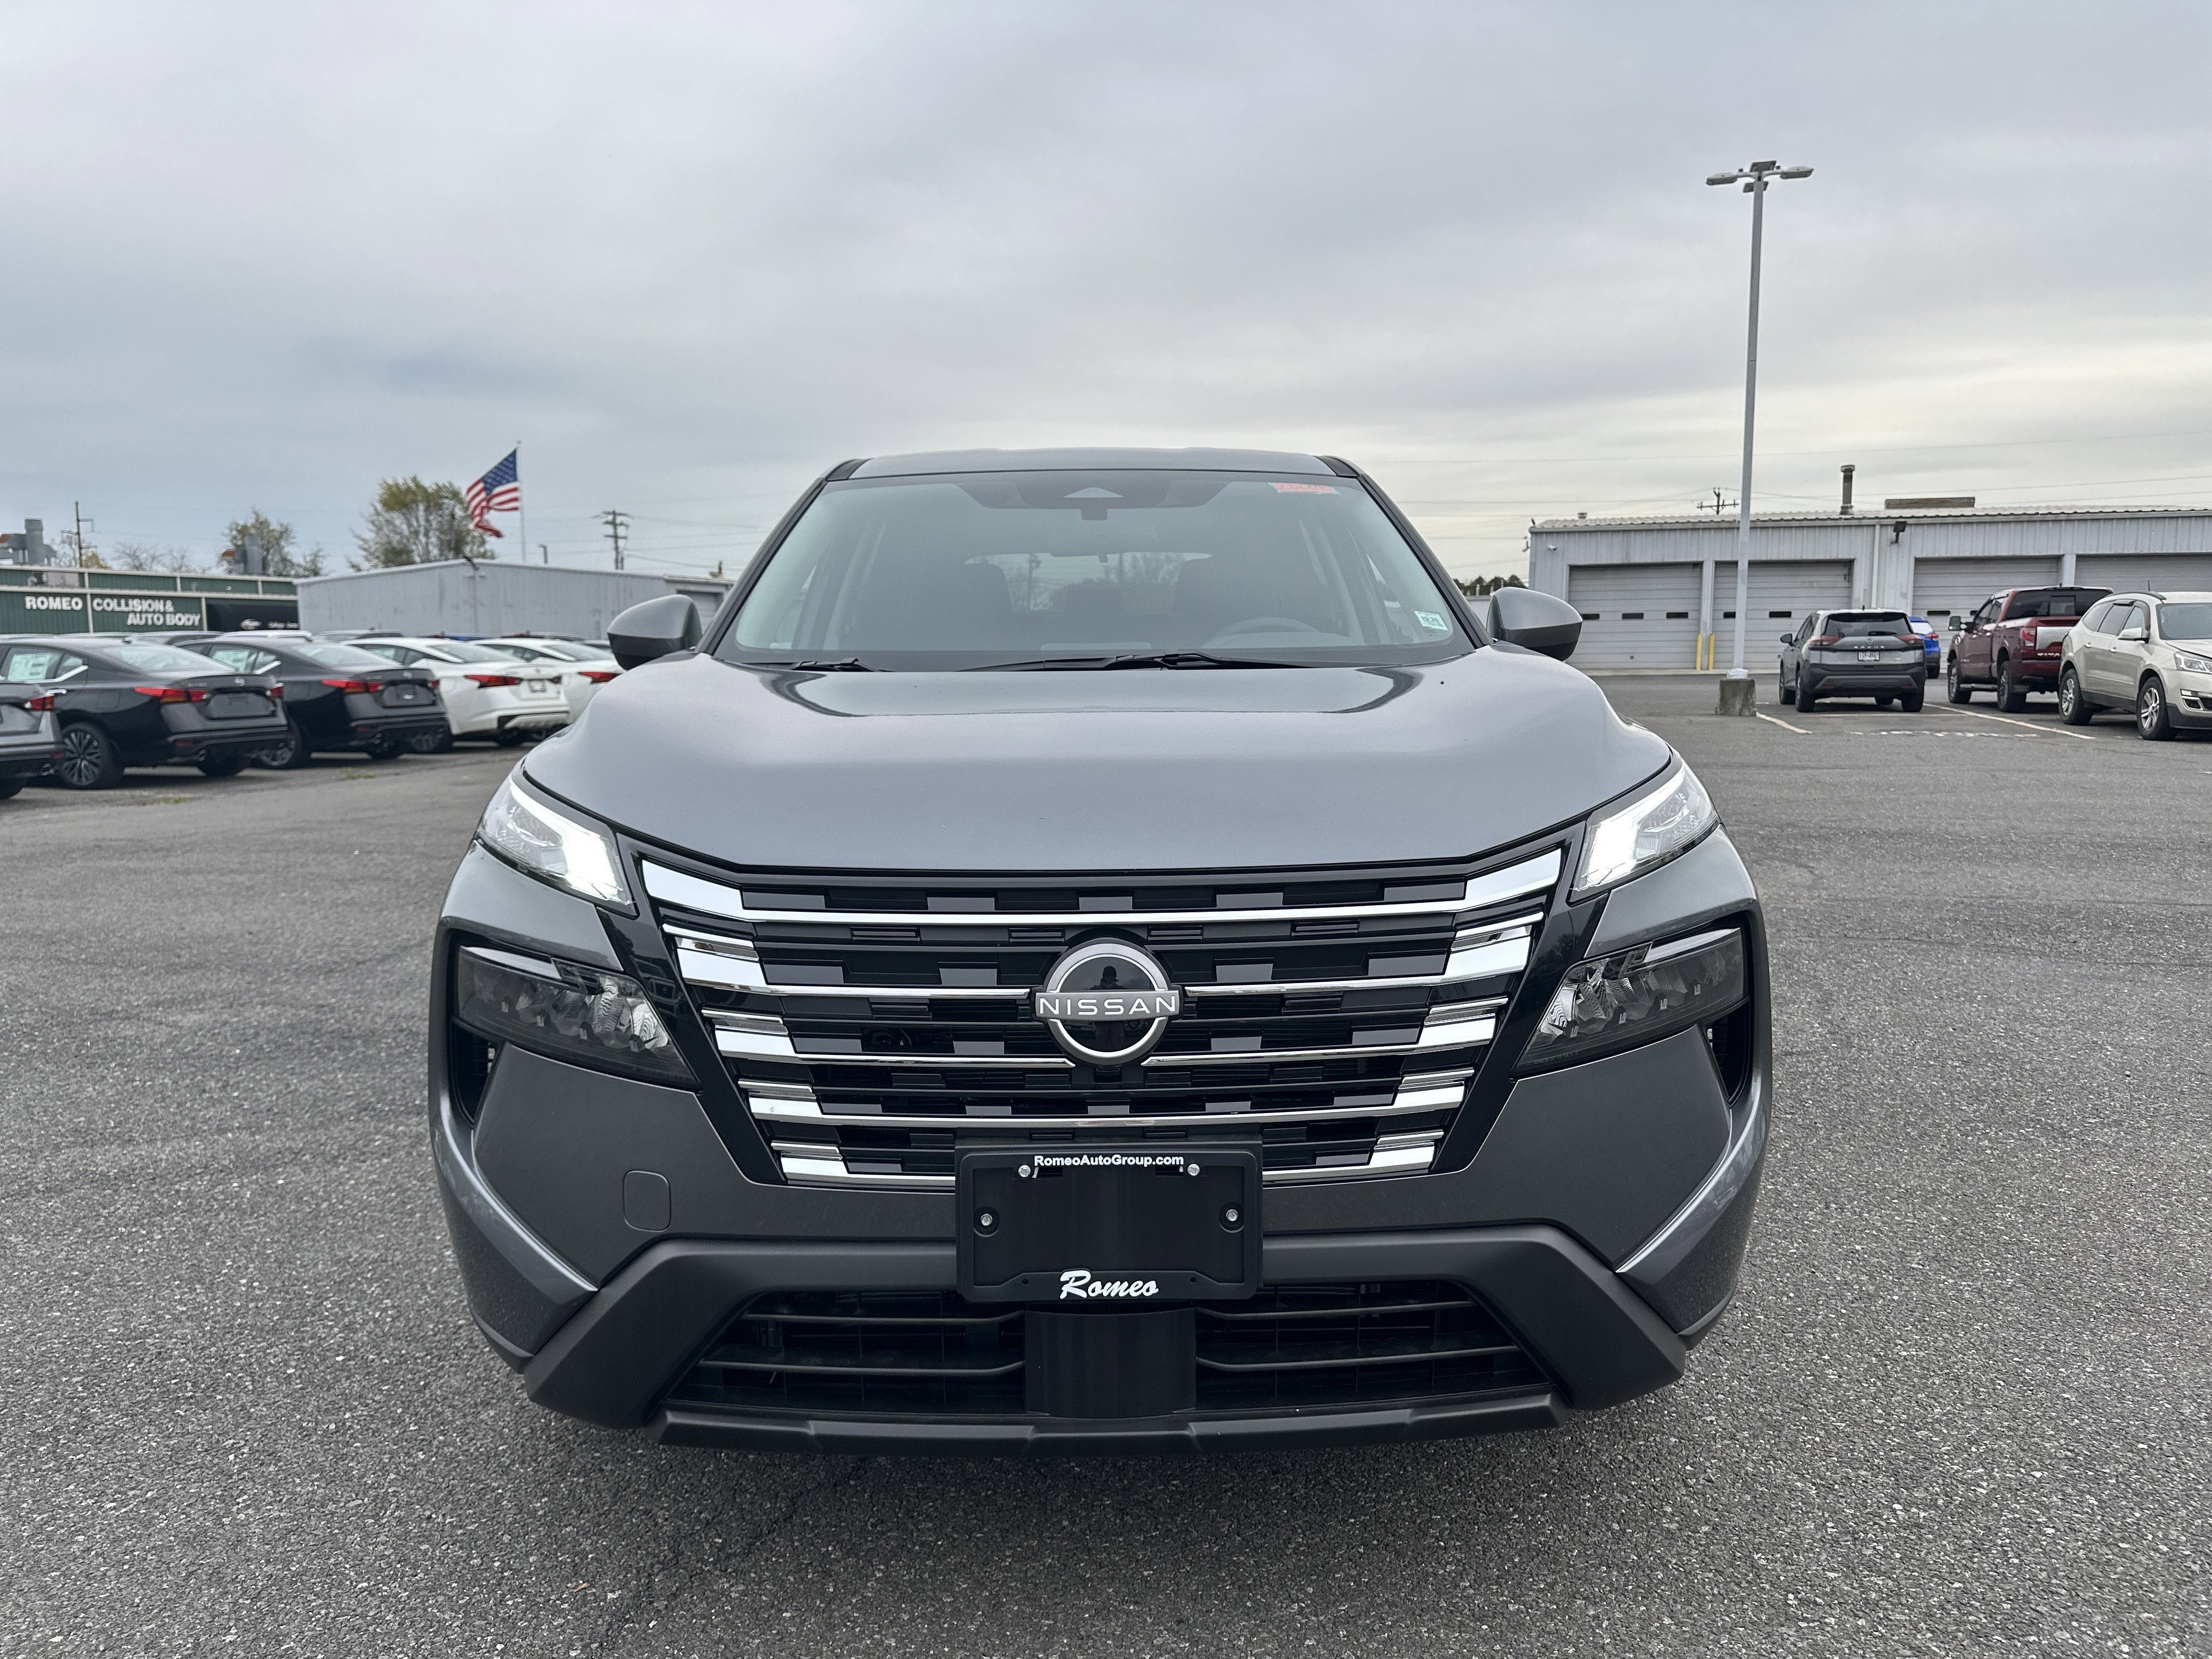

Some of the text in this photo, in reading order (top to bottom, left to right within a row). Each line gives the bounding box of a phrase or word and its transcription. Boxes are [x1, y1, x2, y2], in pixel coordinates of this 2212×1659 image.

[25, 595, 83, 611] ROMEO
[127, 612, 201, 626] AUTO BODY
[1039, 995, 1176, 1015] NISSAN
[1034, 1154, 1184, 1167] RomeoAutoGroup.com
[1059, 1269, 1159, 1300] Romeo
